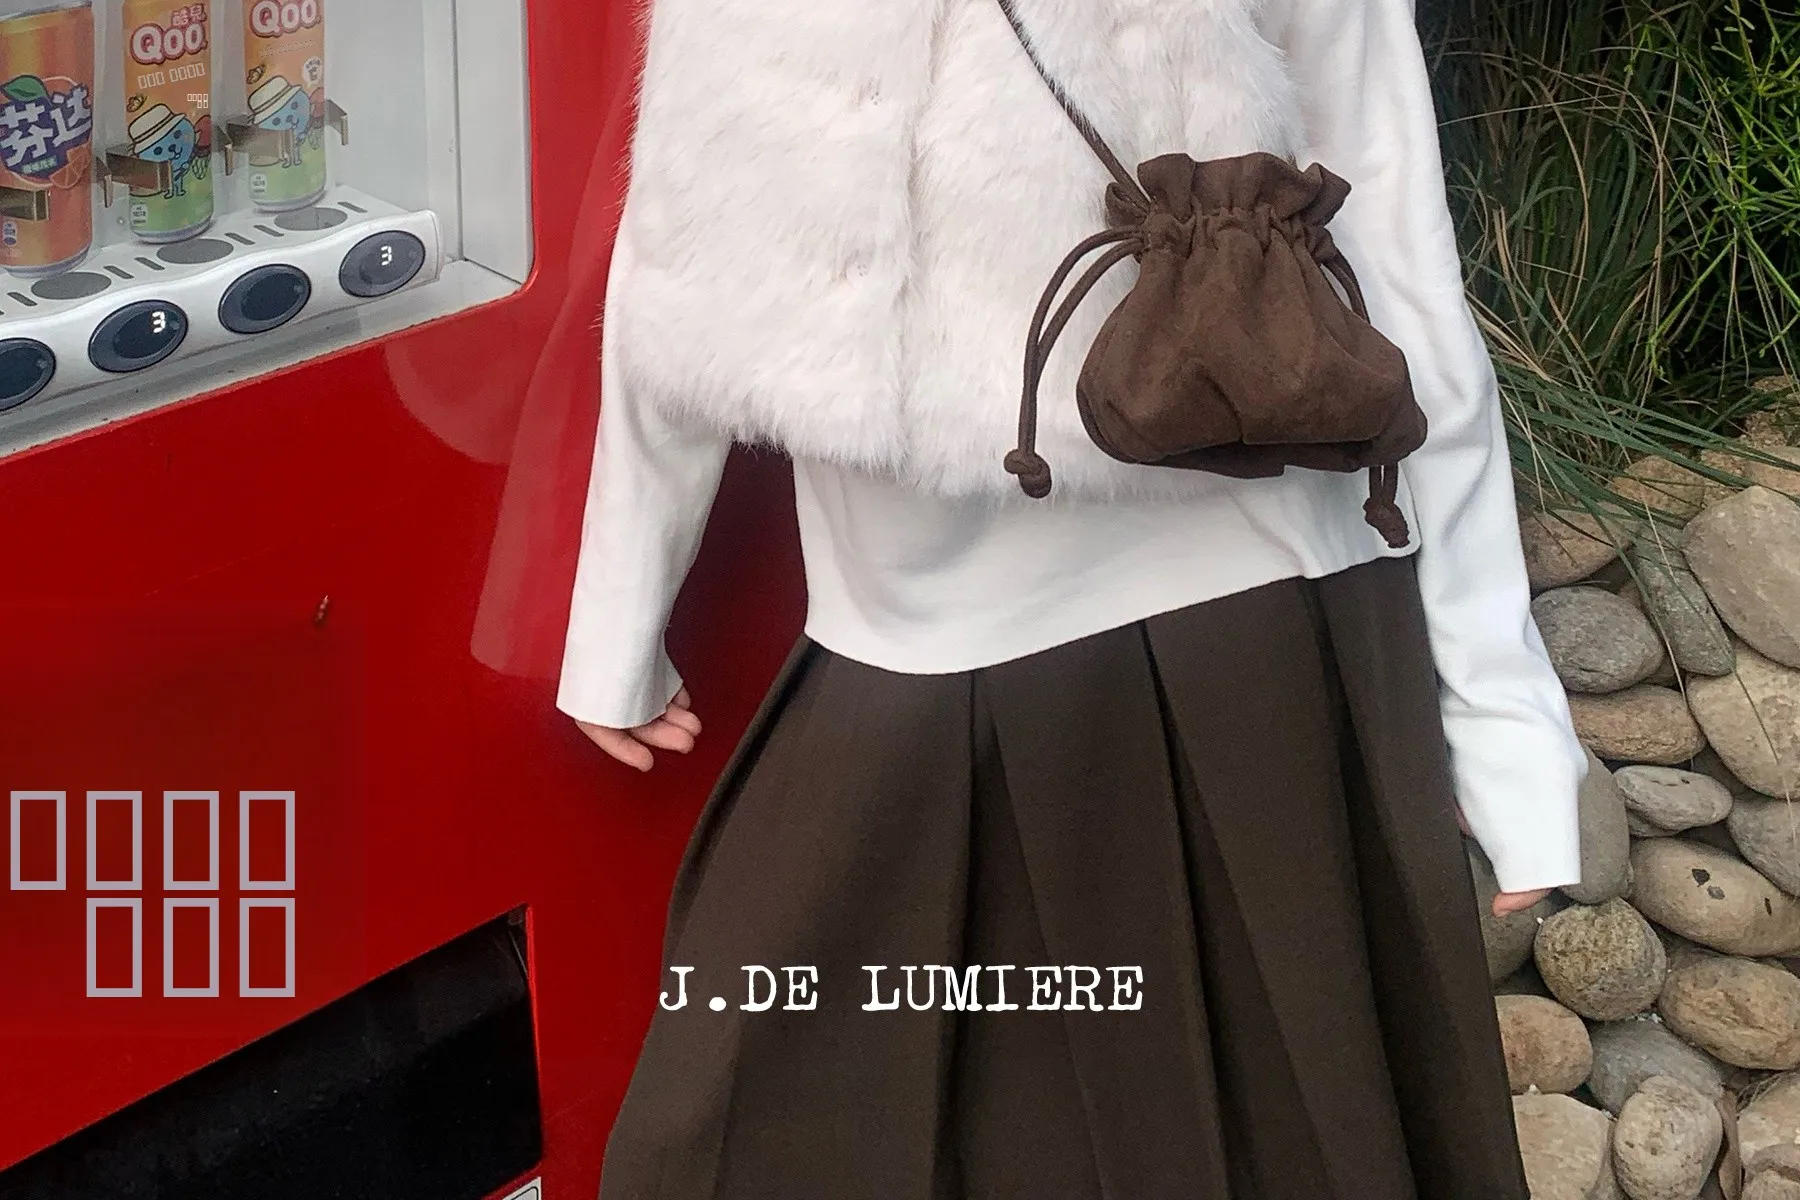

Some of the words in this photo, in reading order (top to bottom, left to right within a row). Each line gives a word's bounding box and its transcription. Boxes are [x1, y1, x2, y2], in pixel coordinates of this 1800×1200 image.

[132, 22, 203, 62] Qoo
[0, 86, 91, 167] 芬达
[381, 245, 392, 266] 3
[152, 311, 166, 333] 3
